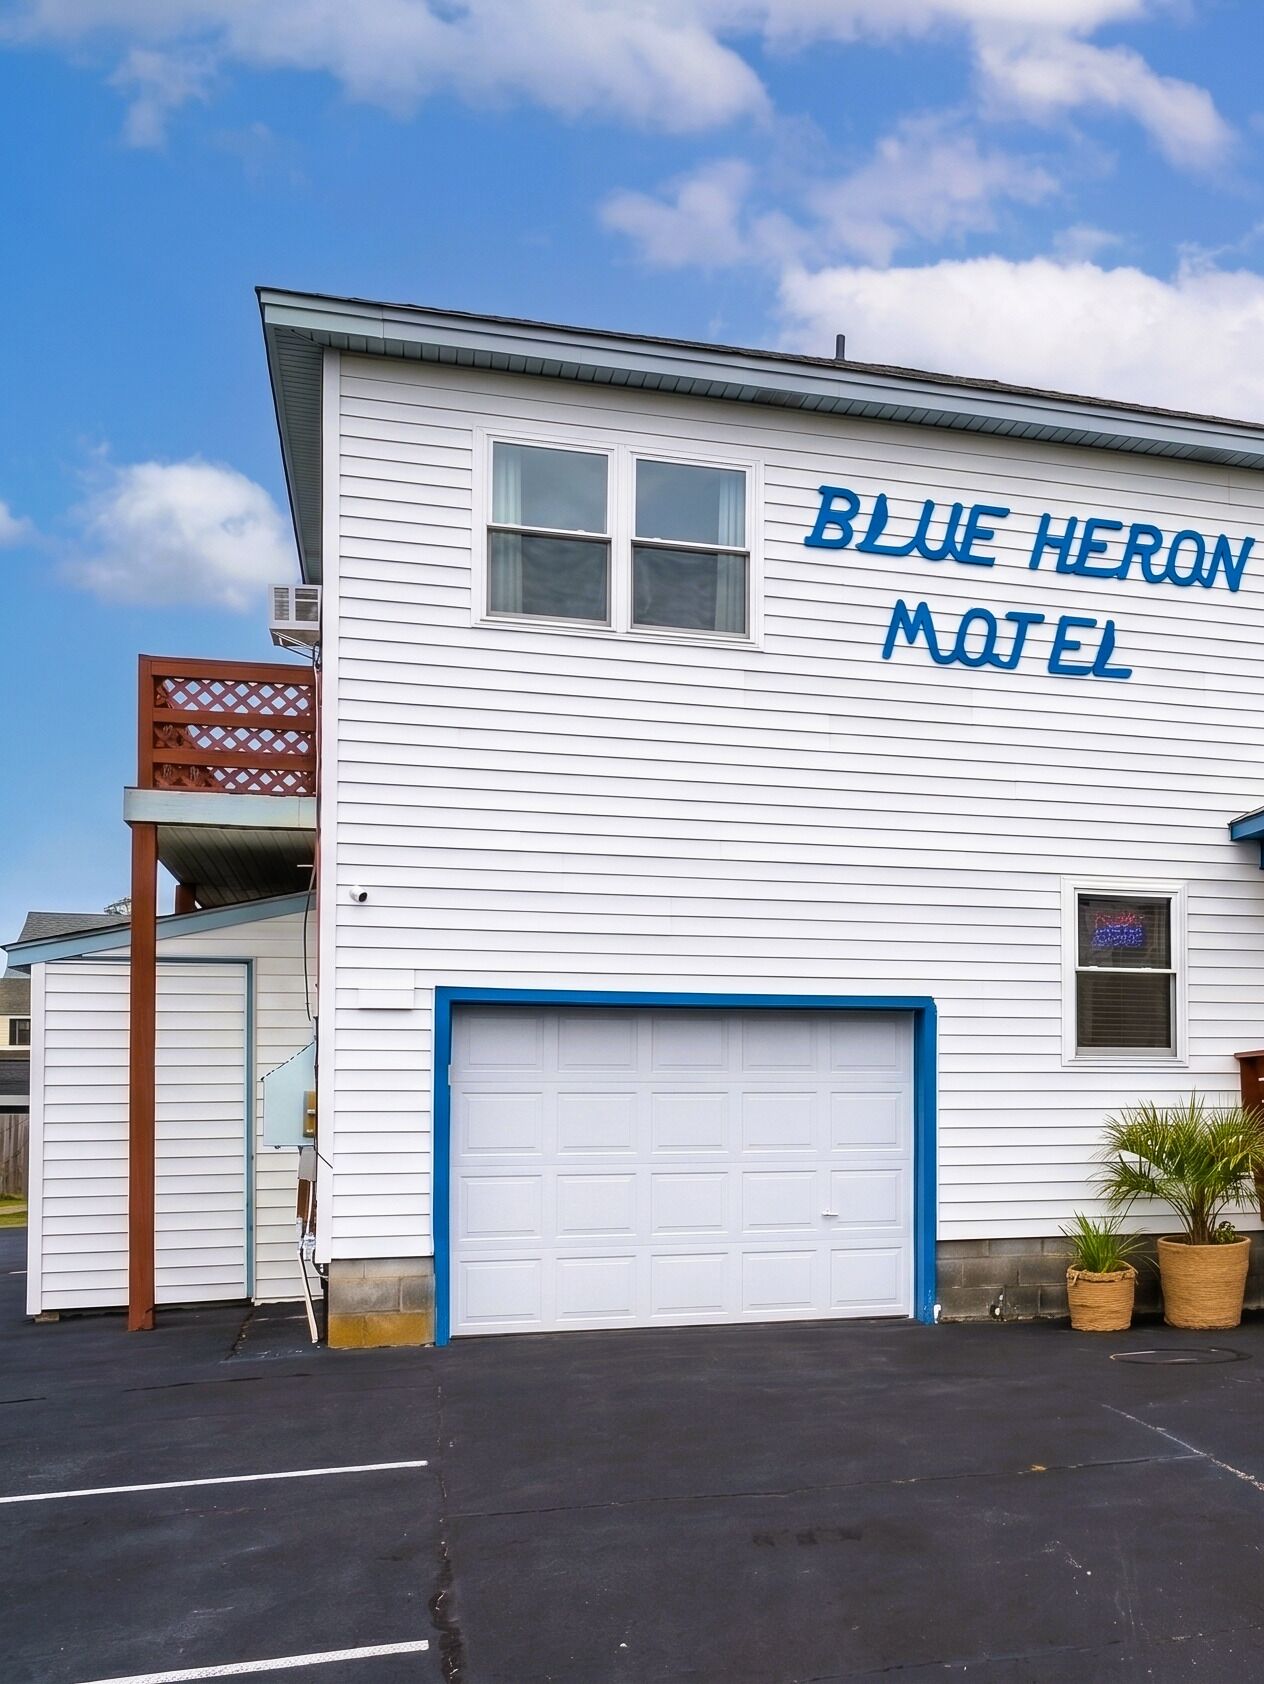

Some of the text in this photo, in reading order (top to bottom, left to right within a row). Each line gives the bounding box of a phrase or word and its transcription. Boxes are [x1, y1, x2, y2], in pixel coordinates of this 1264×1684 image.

[804, 485, 1255, 592] BLUE HERON
[882, 599, 1132, 678] MOTEL
